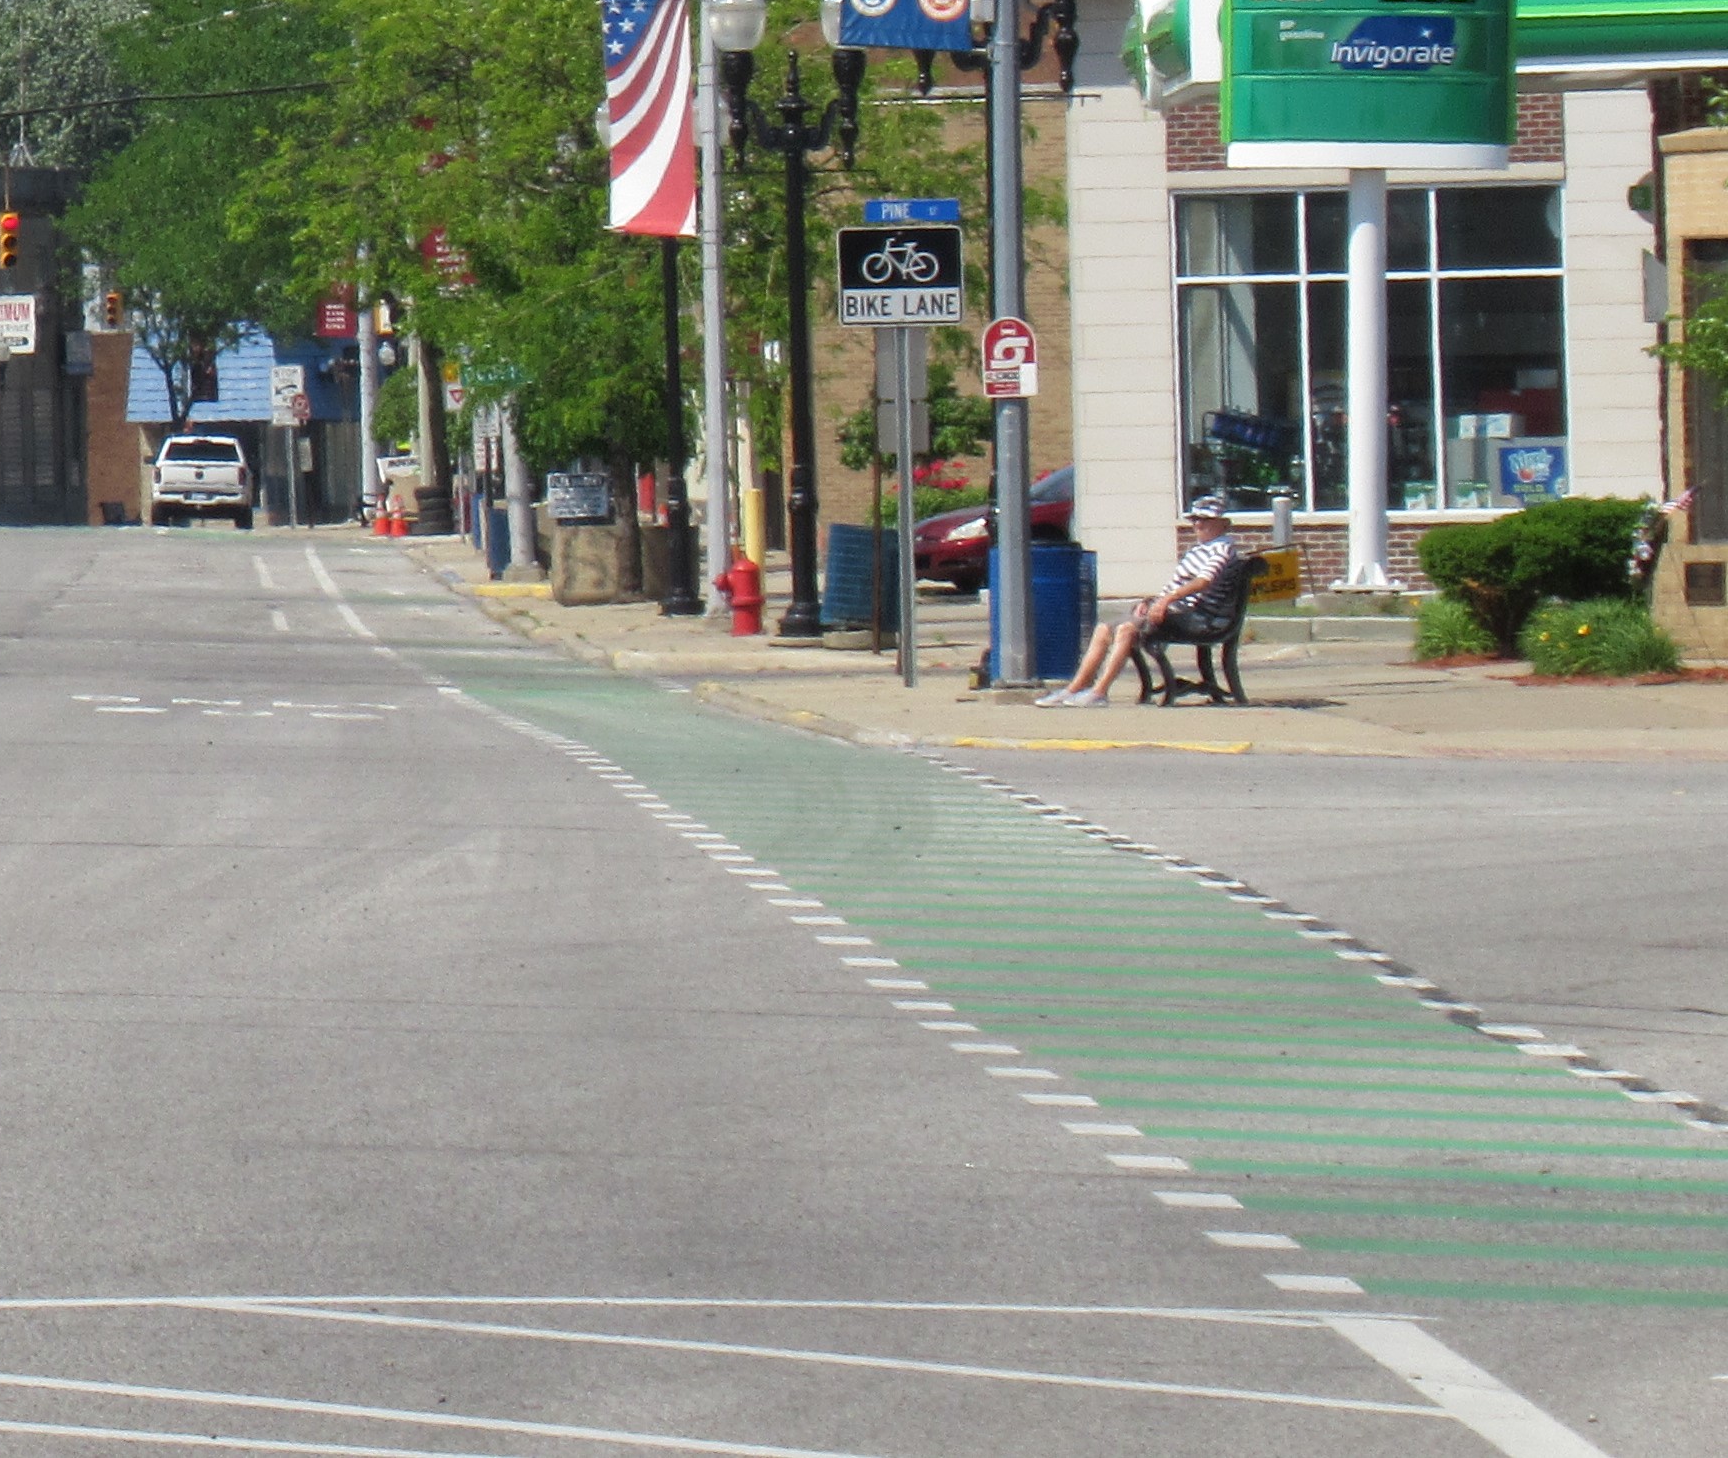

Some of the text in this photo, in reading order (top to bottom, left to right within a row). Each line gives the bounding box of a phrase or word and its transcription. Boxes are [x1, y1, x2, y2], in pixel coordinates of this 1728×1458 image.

[1330, 41, 1455, 69] Invigorate
[880, 202, 911, 220] PINE
[845, 293, 958, 318] BIKE LANE
